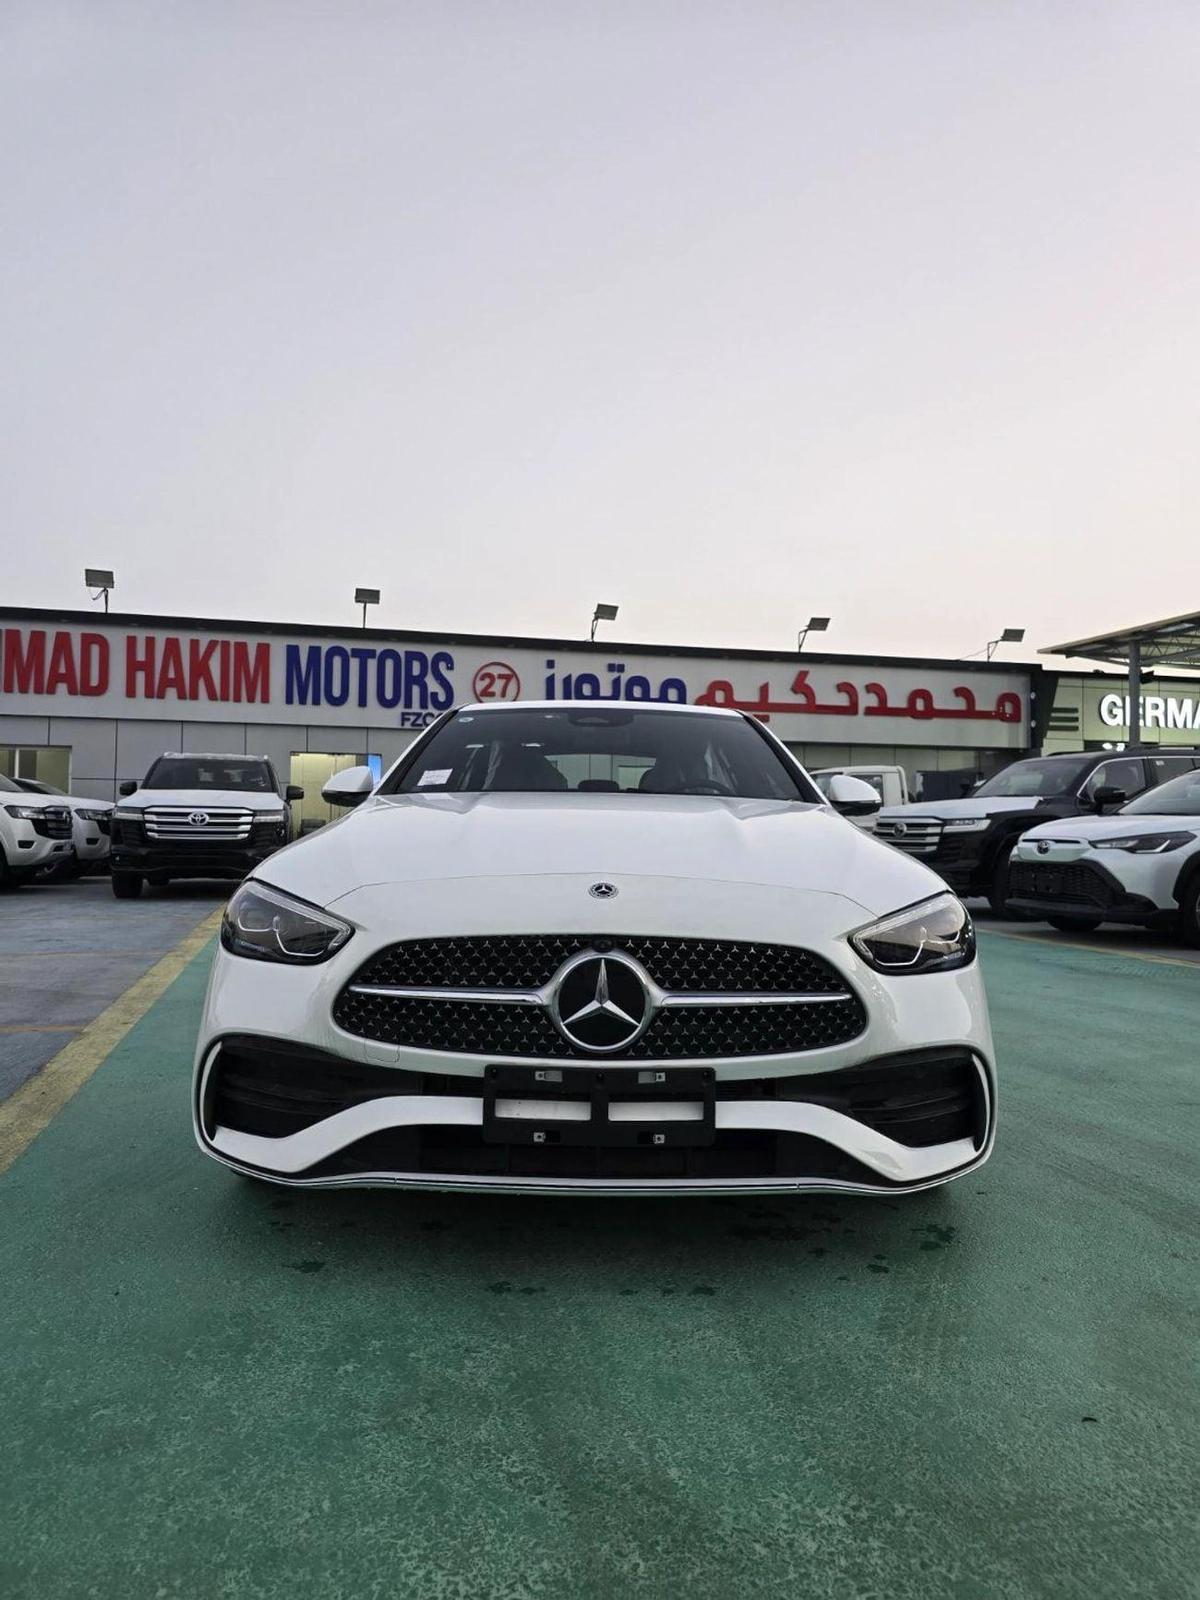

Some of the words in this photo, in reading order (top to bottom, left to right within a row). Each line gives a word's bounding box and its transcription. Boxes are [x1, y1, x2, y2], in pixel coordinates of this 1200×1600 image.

[0, 628, 110, 697] MAD
[125, 635, 271, 704] HAKIM
[285, 644, 455, 711] MOTORS
[479, 672, 514, 698] 27
[401, 711, 443, 727] FZC
[1100, 693, 1200, 729] GERM
